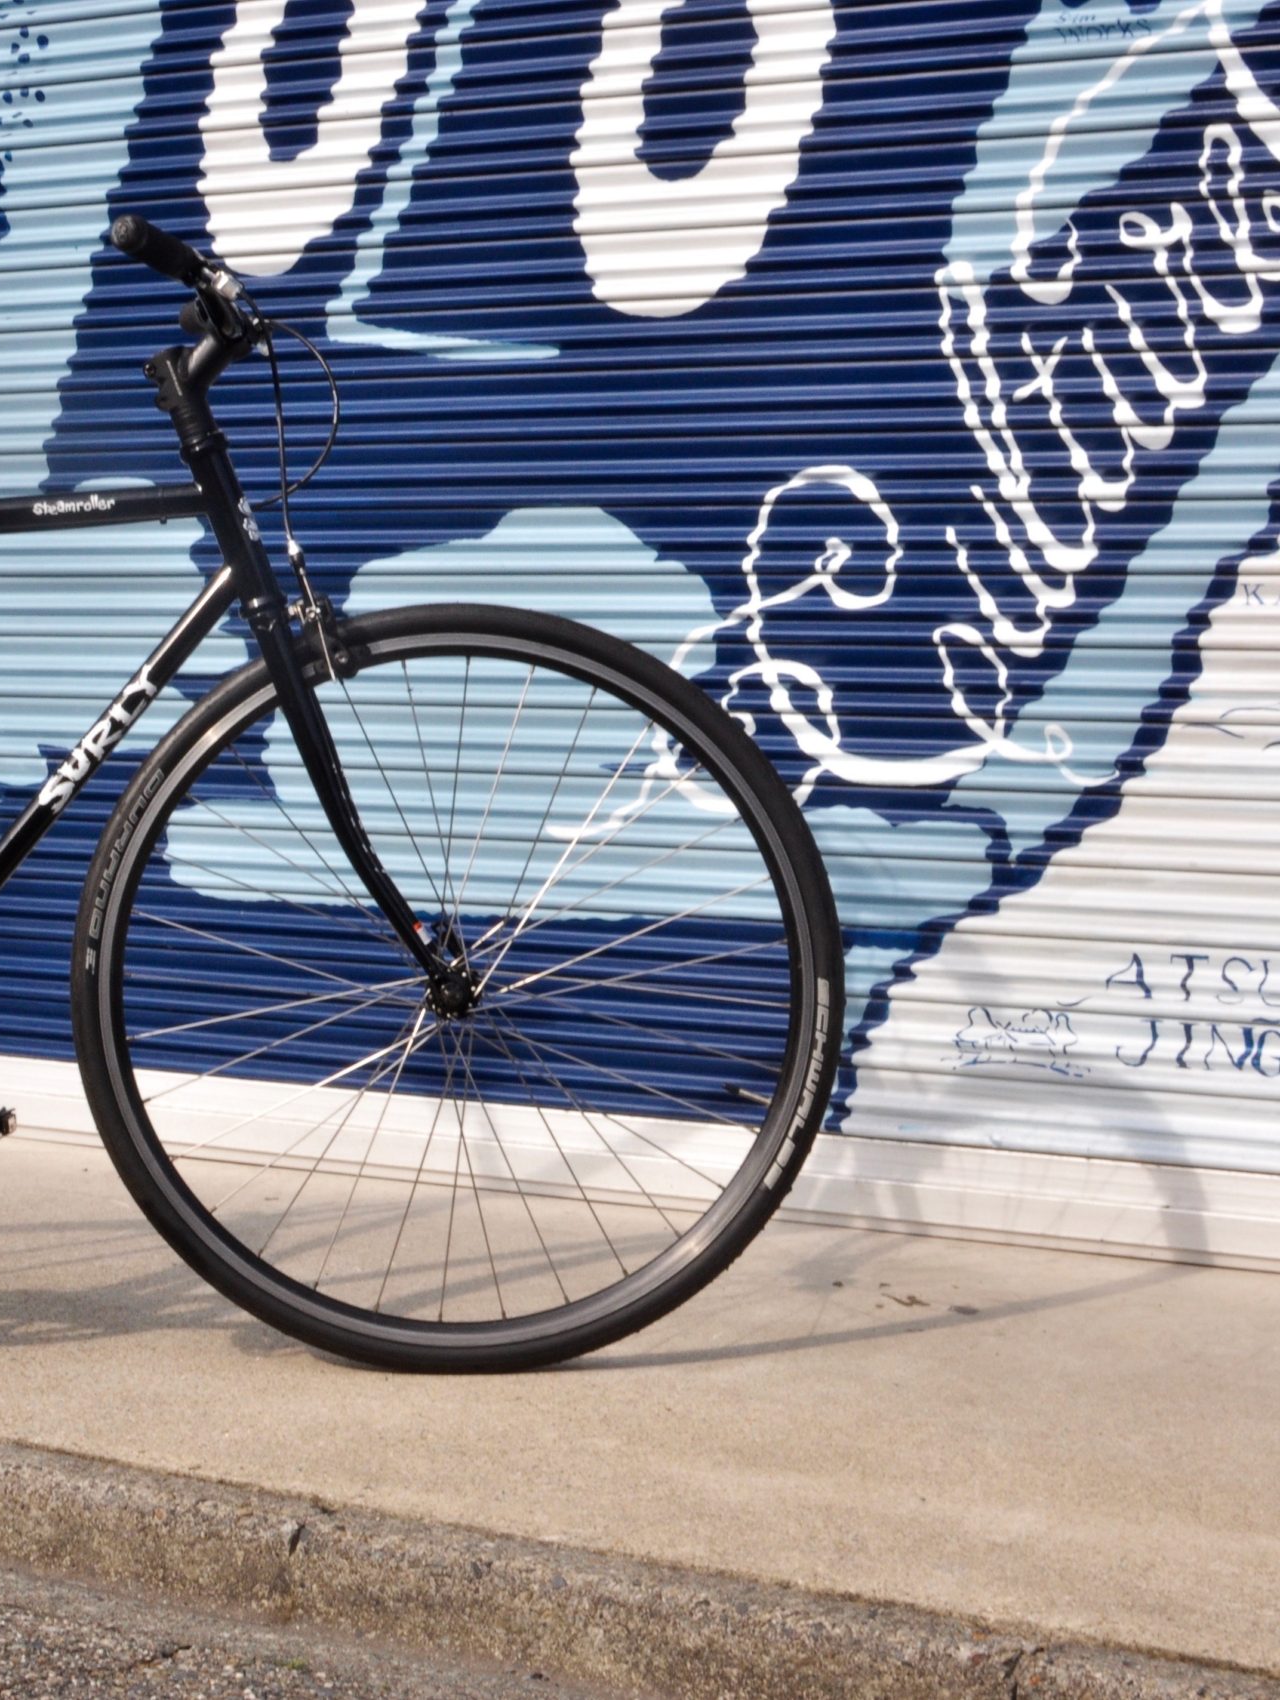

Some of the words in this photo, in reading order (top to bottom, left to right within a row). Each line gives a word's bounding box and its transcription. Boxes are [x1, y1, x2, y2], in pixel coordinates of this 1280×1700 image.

[33, 494, 115, 516] Steamroller
[38, 664, 158, 813] SURLY
[762, 977, 830, 1191] SCHWALBE
